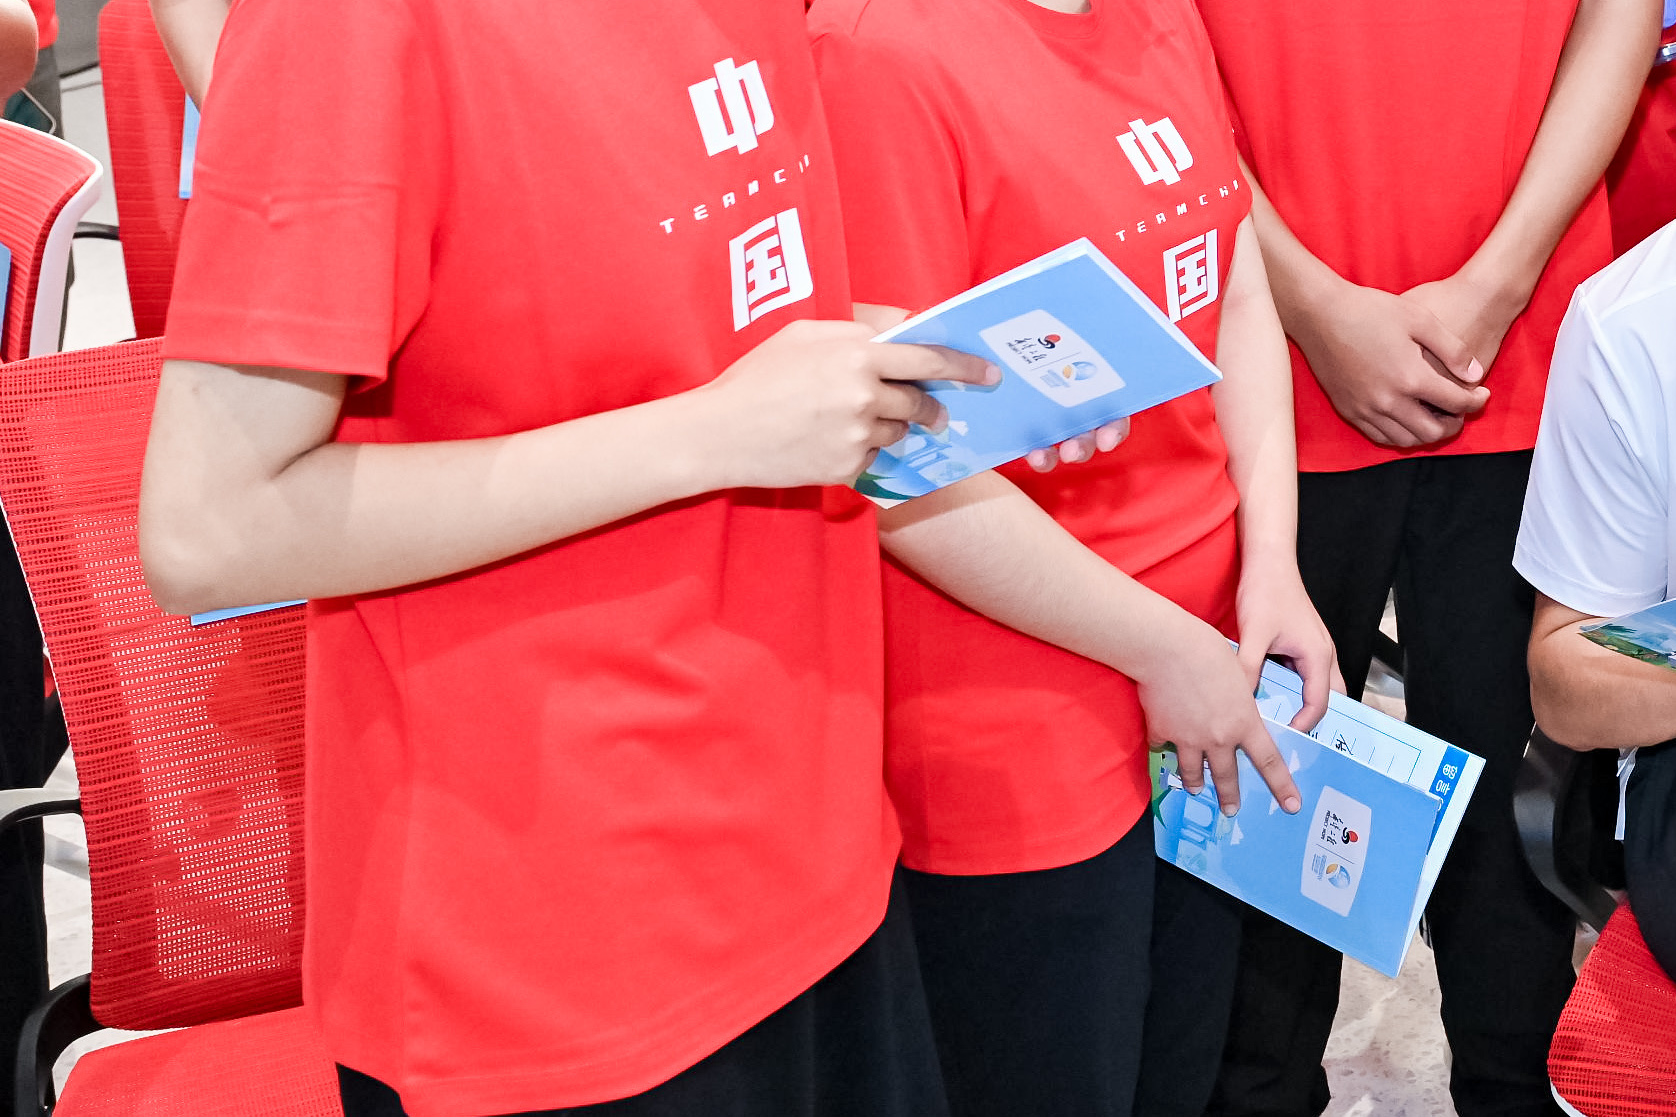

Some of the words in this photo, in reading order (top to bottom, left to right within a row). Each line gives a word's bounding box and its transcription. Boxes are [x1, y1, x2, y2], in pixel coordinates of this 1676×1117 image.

[688, 57, 775, 157] 中
[1115, 116, 1194, 186] 中
[728, 207, 814, 333] 国
[1163, 228, 1219, 323] 国
